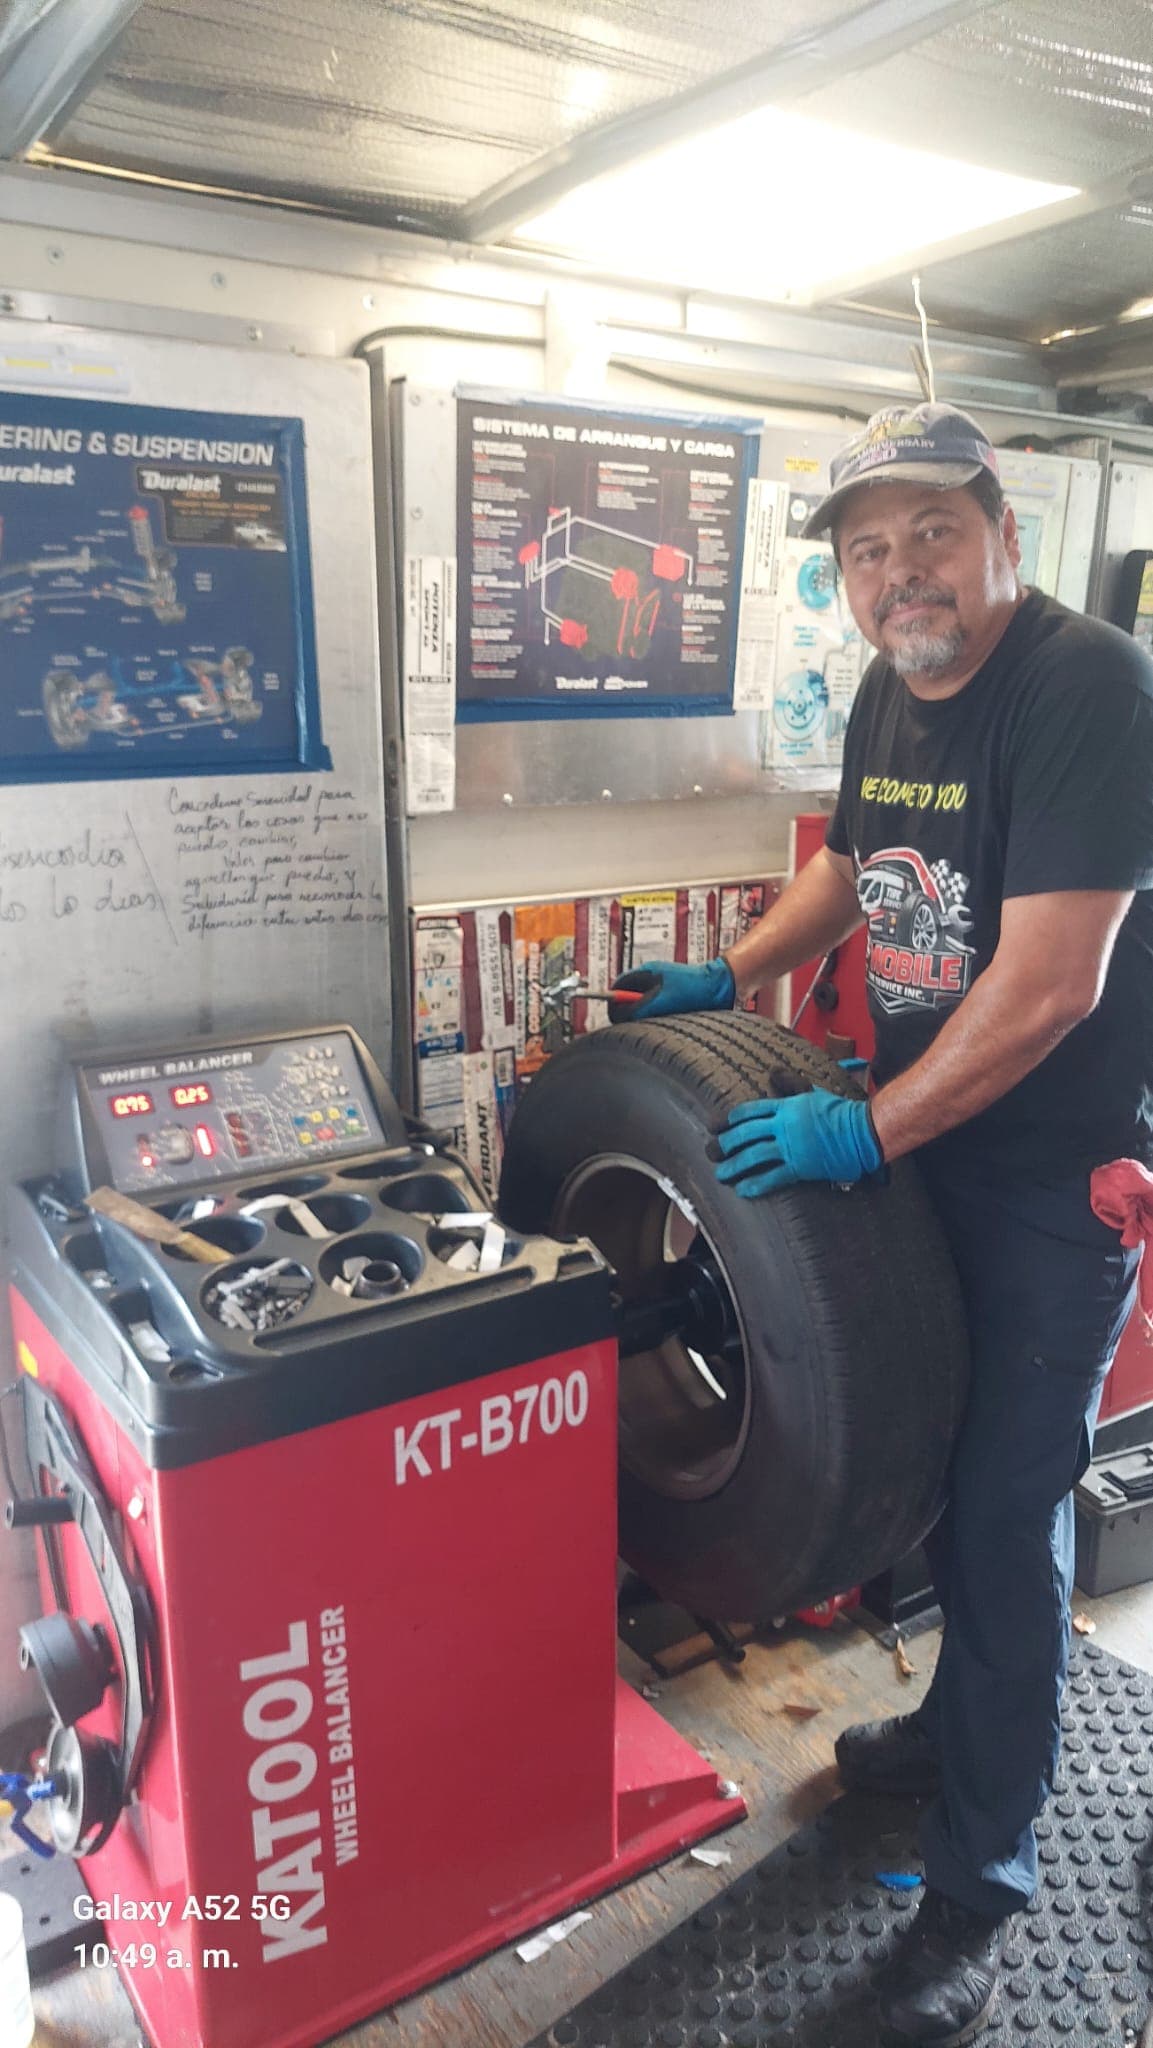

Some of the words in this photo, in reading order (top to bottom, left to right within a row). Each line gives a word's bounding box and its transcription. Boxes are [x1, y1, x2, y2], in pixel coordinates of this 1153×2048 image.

[0, 424, 83, 454] ERING
[87, 429, 107, 455] &
[112, 432, 275, 467] SUSPENSION
[472, 416, 550, 439] SISTEMA
[553, 426, 577, 442] DE
[579, 429, 667, 452] ARRANQUE
[670, 438, 682, 453] Y
[684, 439, 735, 458] CARGA
[0, 462, 76, 486] uralast
[141, 469, 221, 494] Duralast
[935, 783, 968, 811] YOU
[870, 944, 963, 991] MOBILE
[876, 977, 904, 996] SERVICE
[903, 985, 926, 1002] INC.
[99, 1064, 160, 1085] WHEEL
[163, 1051, 253, 1076] BALANCER
[475, 1101, 492, 1196] VERDANT
[394, 1370, 590, 1486] KT-B700
[320, 1604, 353, 1763] BALANCER
[239, 1620, 329, 1963] KATOOL
[331, 1767, 359, 1866] WHEEL
